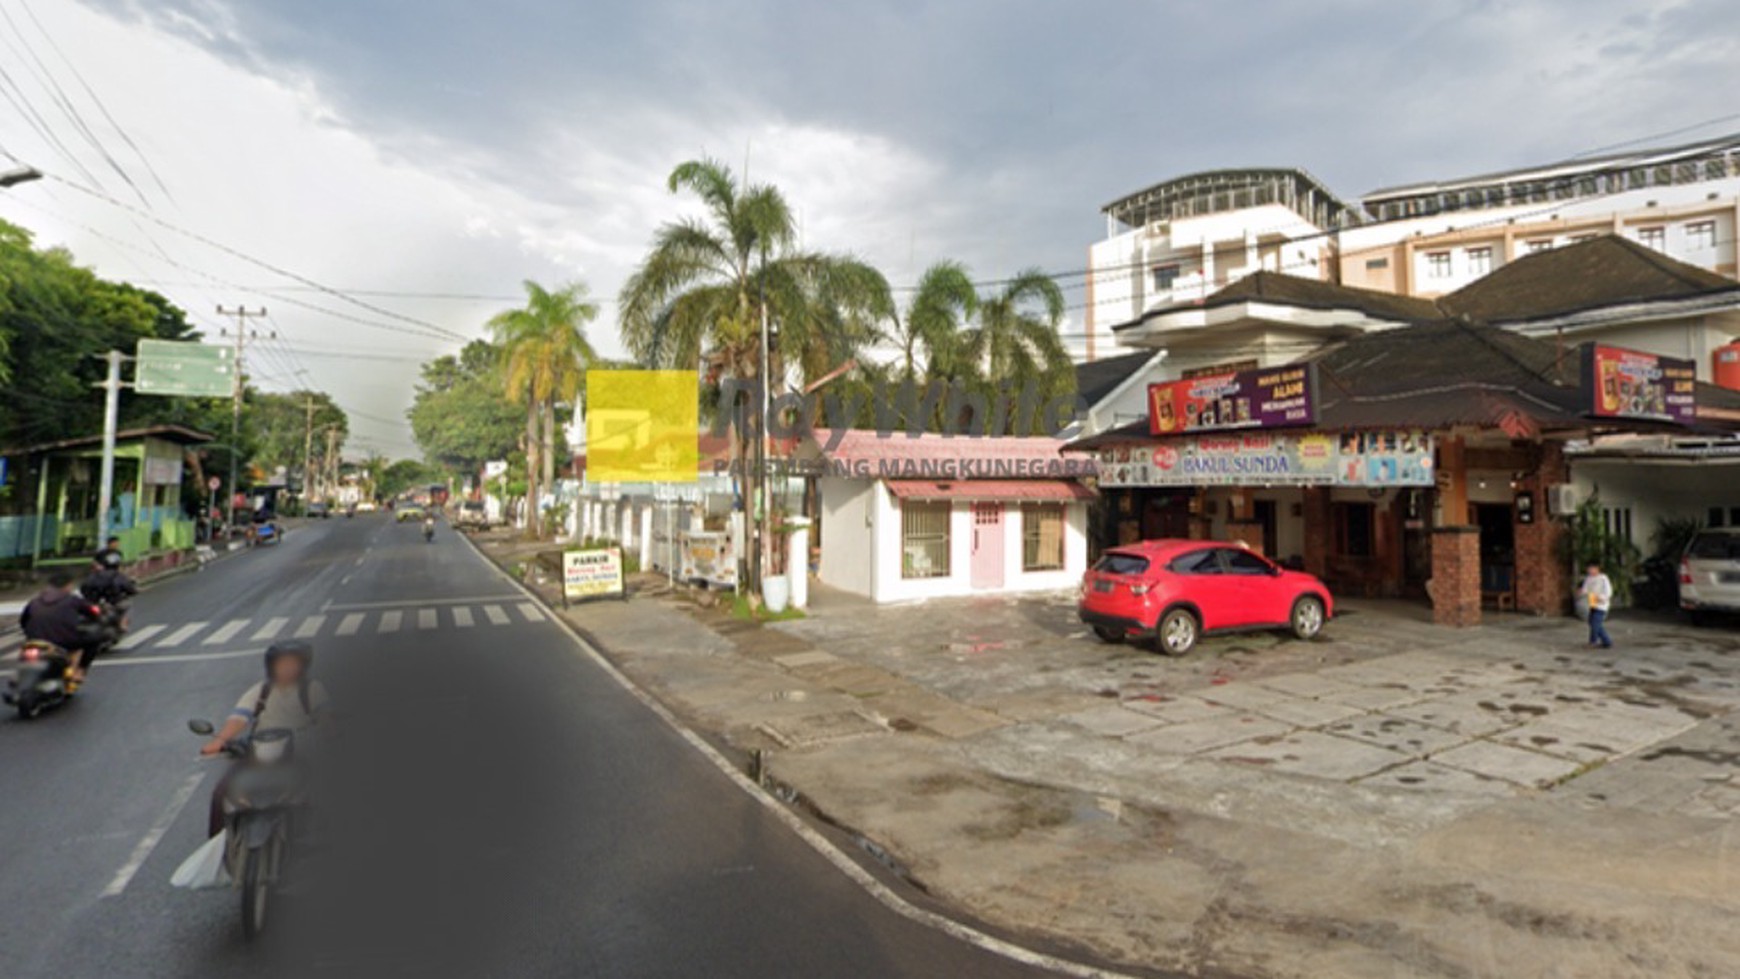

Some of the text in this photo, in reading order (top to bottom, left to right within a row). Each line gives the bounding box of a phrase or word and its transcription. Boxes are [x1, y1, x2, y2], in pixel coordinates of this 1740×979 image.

[1183, 455, 1289, 473] BAKUL SUNDA
[573, 555, 609, 565] PARKIR
